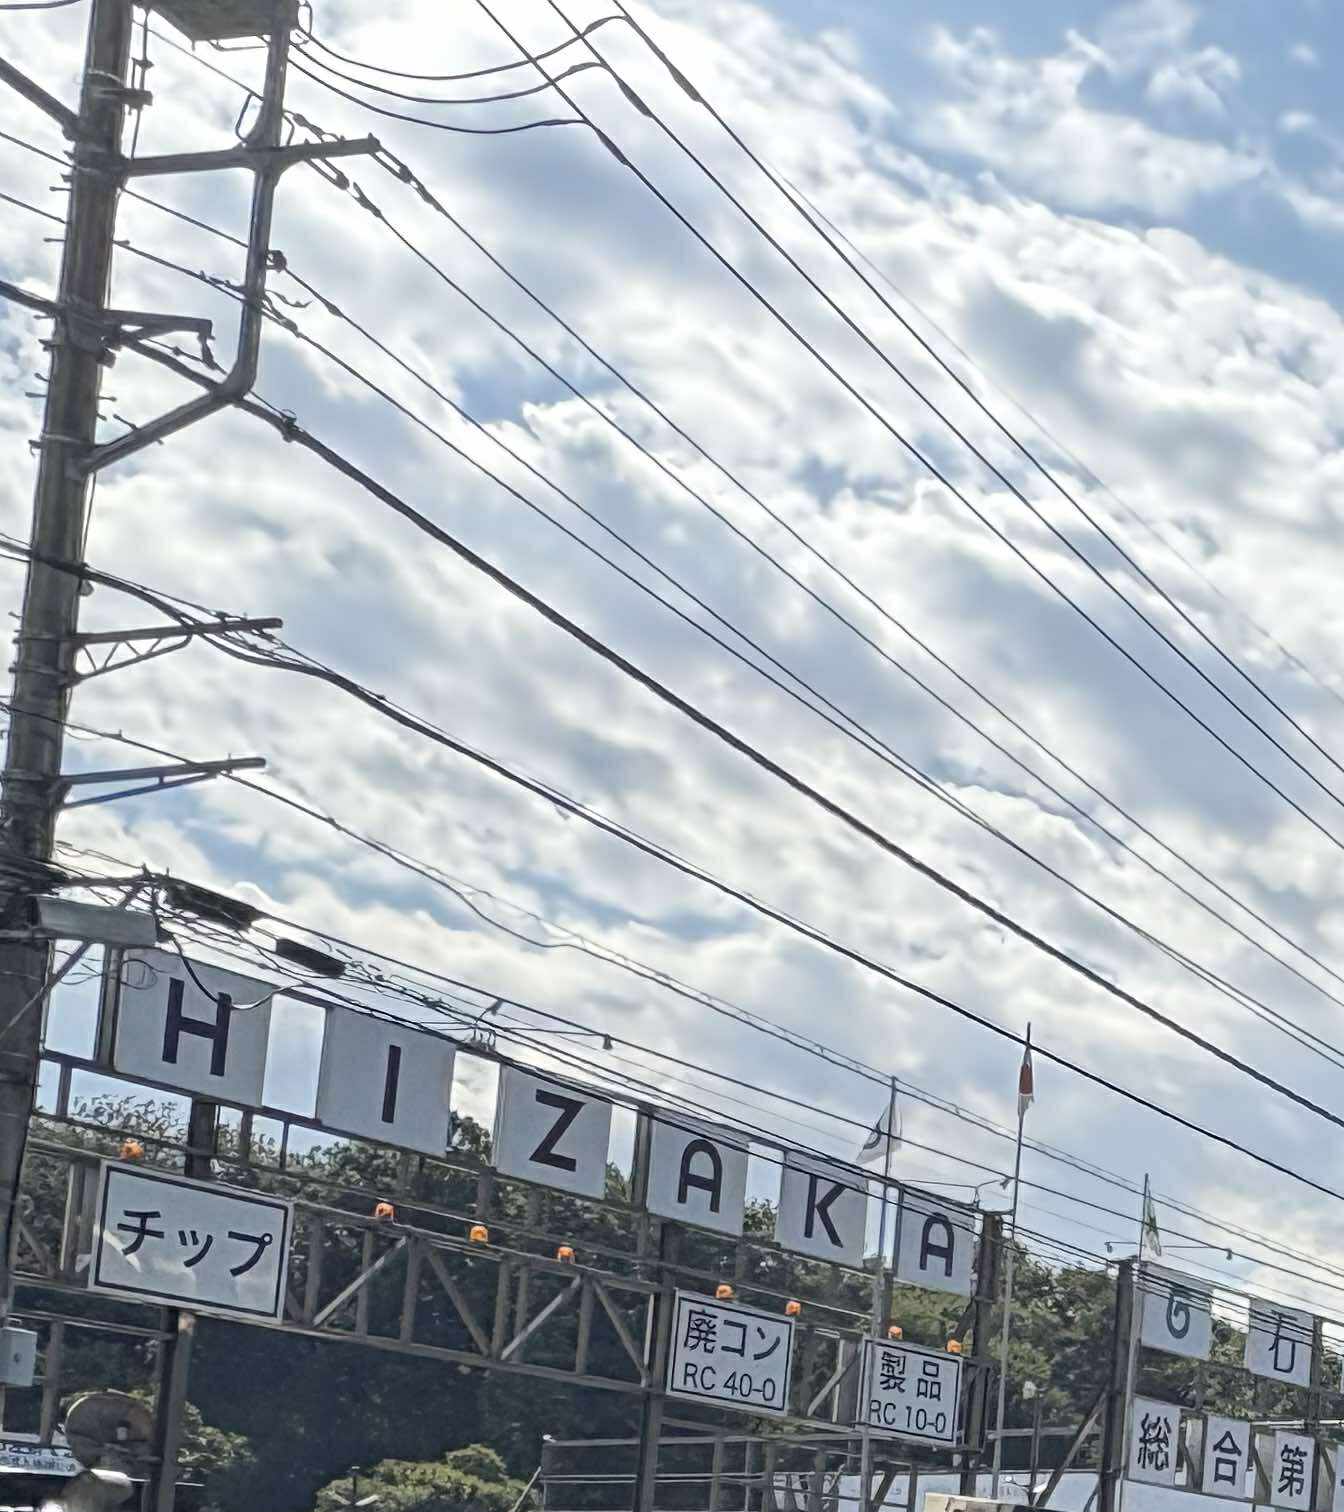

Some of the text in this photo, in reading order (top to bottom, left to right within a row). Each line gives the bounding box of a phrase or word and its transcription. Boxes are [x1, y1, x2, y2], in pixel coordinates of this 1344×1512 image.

[117, 1210, 273, 1277] チップ
[684, 1309, 781, 1361] 廃コン
[683, 1362, 776, 1402] RC 40-0
[880, 1350, 942, 1402] 製品
[869, 1399, 947, 1434] RC 10-0
